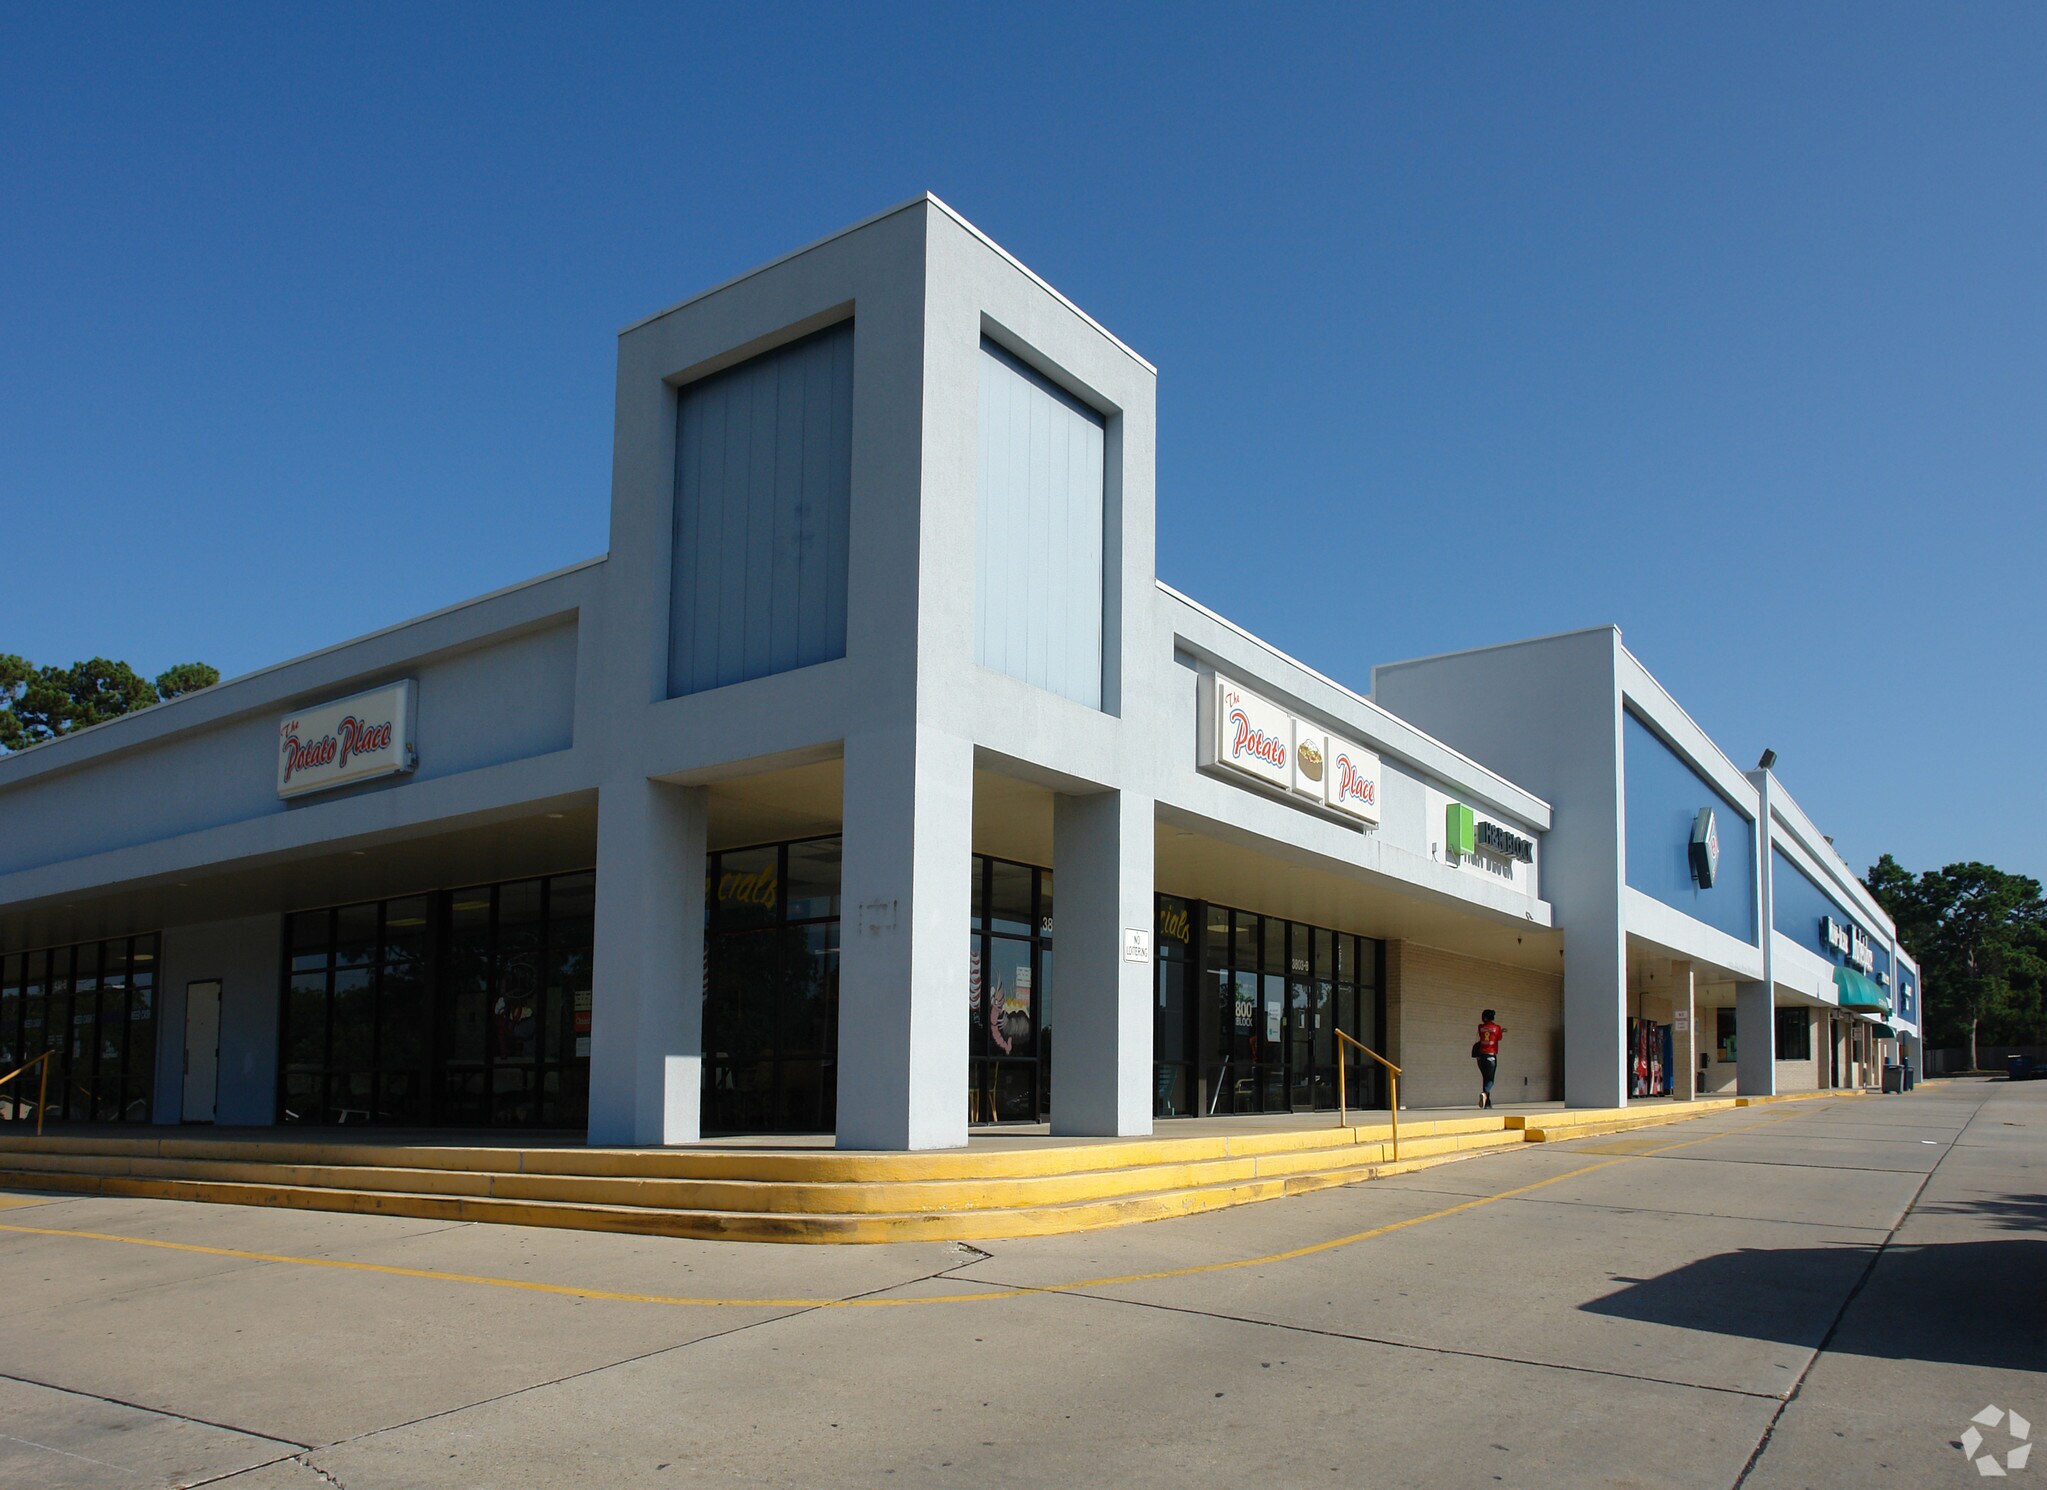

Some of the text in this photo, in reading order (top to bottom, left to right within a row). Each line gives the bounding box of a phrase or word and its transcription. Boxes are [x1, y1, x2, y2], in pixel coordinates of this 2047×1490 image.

[1225, 691, 1240, 708] The
[280, 720, 299, 739] The
[283, 716, 392, 783] Potato Place
[1230, 708, 1375, 805] Potato Place
[1479, 821, 1533, 863] H&R BLOCK
[706, 863, 778, 909] cials
[1042, 916, 1053, 932] 38
[1133, 935, 1141, 945] NO
[1126, 945, 1148, 958] LOITERING
[1235, 1001, 1252, 1018] 800
[1235, 1017, 1253, 1027] BLOCK
